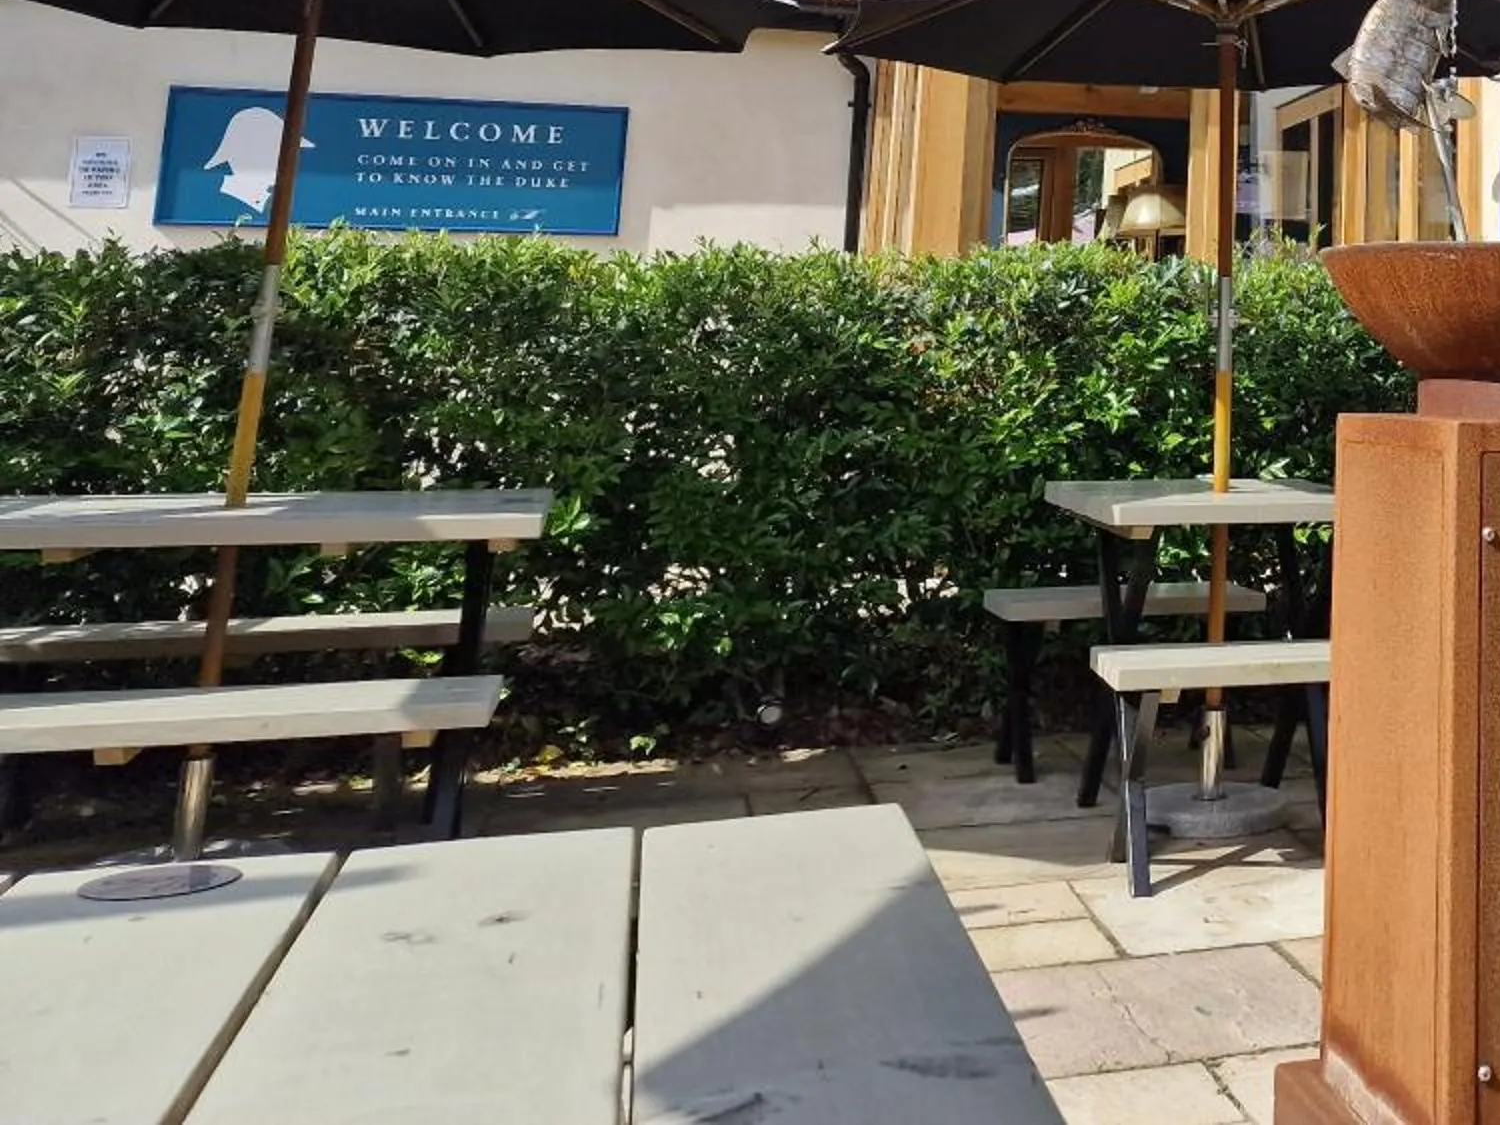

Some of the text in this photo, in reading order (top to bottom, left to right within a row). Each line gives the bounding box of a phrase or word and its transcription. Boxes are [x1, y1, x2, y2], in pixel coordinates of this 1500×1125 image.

[357, 118, 566, 145] WELCOME
[357, 153, 590, 173] COME ON IN AND GET
[356, 172, 570, 188] TO KNOW THE DUKE
[355, 207, 500, 219] MAIN ENTRANCE
